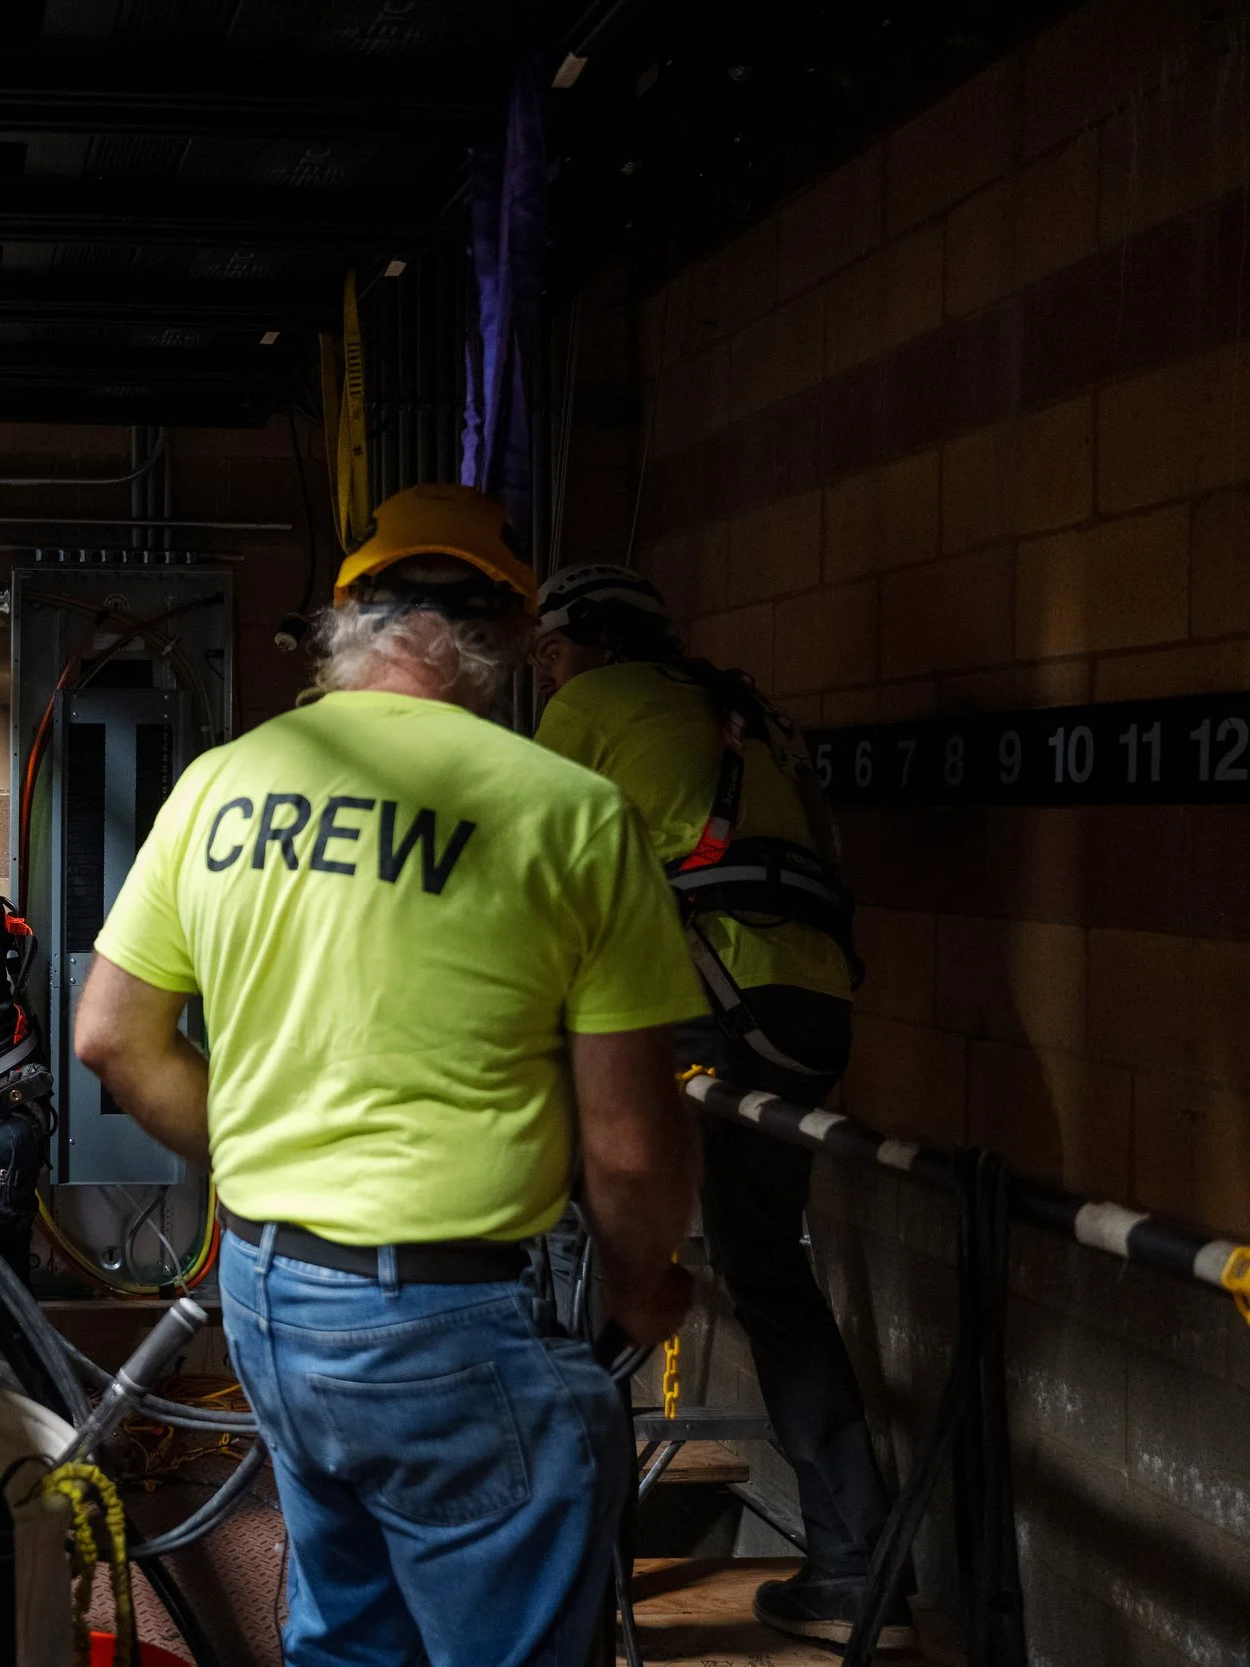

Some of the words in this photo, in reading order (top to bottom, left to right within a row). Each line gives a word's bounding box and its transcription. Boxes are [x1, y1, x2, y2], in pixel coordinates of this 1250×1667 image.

[817, 743, 833, 789] 5
[855, 740, 873, 788] 6
[897, 738, 917, 788] 7
[944, 734, 965, 787] 8
[998, 730, 1022, 785] 9
[1048, 725, 1095, 783] 10
[1119, 720, 1163, 783] 11
[1189, 716, 1249, 782] 12
[207, 793, 476, 894] CREW
